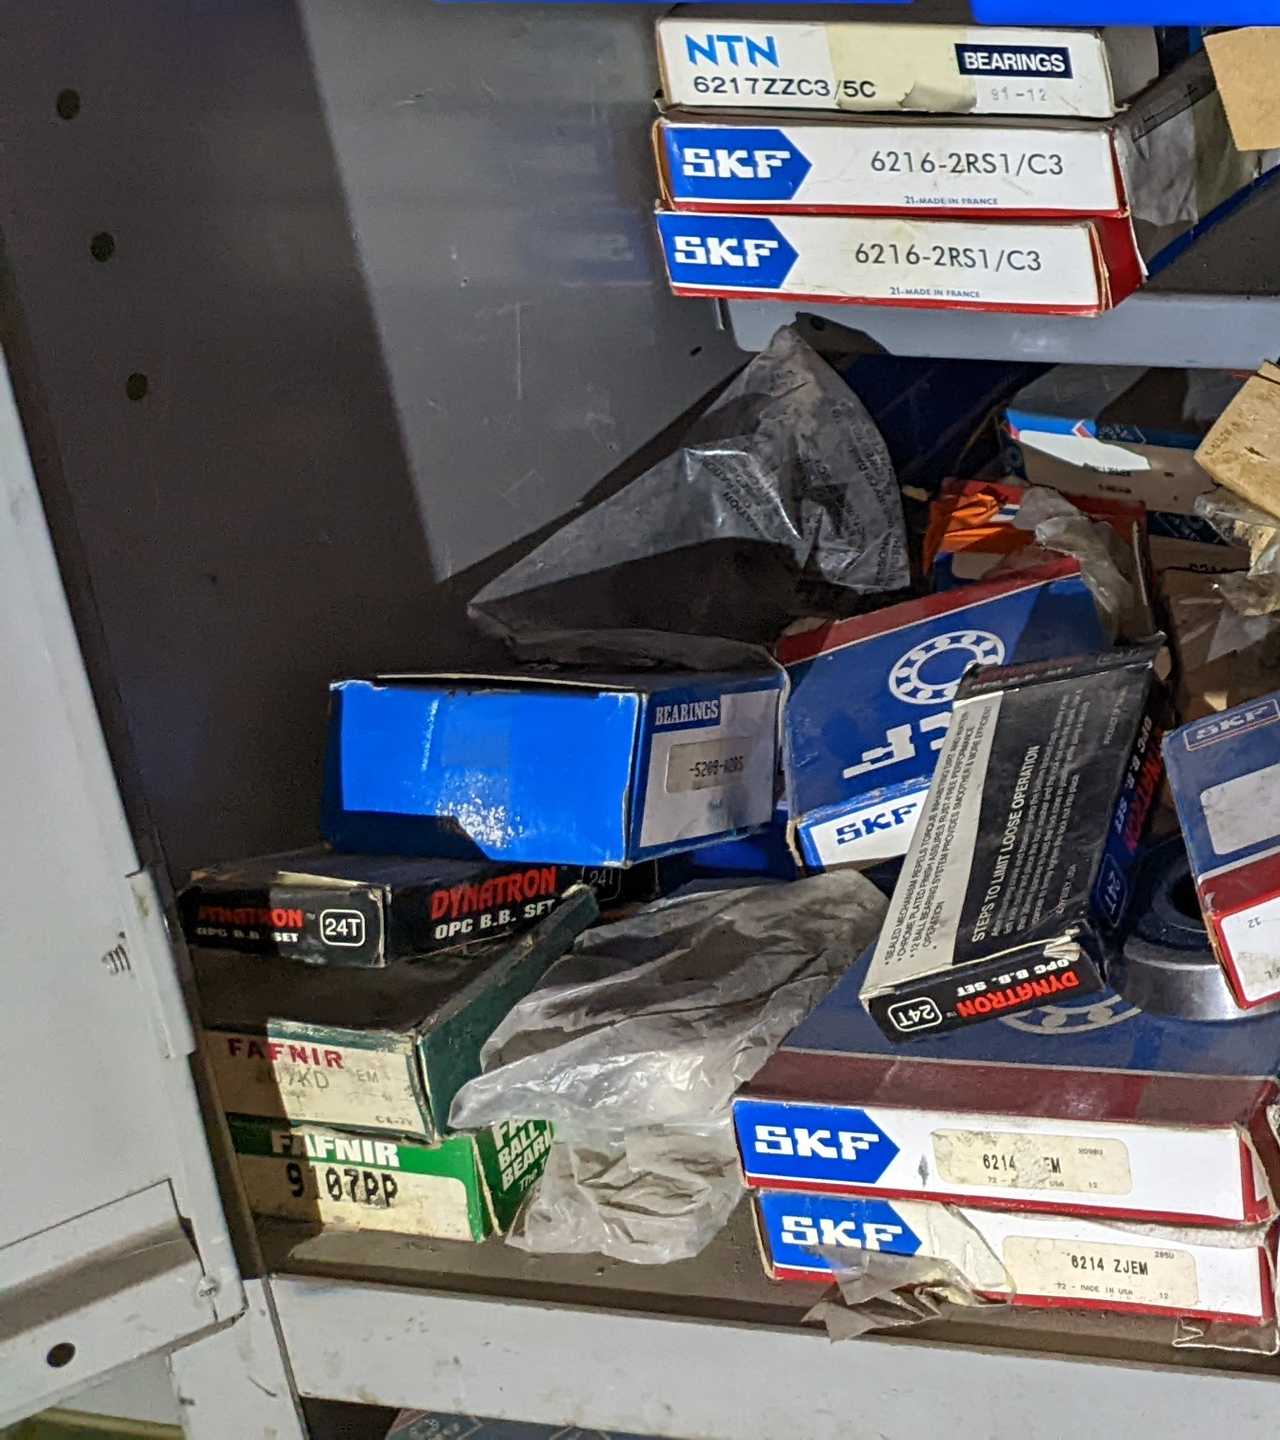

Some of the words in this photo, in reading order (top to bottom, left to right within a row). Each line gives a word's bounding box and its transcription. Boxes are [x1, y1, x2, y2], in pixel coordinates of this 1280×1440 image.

[685, 34, 780, 68] NTN
[963, 52, 1066, 74] BEARINGS
[693, 76, 877, 101] 6217ZZC3/5C
[682, 147, 791, 180] SKF
[871, 150, 1064, 178] 6216-2RS1/C3
[961, 197, 998, 206] FRANCE
[674, 236, 779, 267] SKF
[854, 243, 1042, 273] 6216-2RS1/C3
[945, 289, 981, 299] FRANCE
[655, 699, 719, 727] BEARINGS
[1195, 704, 1273, 736] SKF
[1011, 742, 1041, 808] OPERATION
[836, 802, 918, 846] SKF
[998, 808, 1023, 853] LOOSE
[990, 852, 1010, 883] LIMIT
[430, 867, 557, 921] DYNATRON
[984, 882, 1001, 903] TO
[324, 917, 361, 938] 24T
[434, 919, 474, 941] OPC
[480, 907, 517, 929] B.B.
[524, 899, 556, 920] SET
[921, 899, 945, 947] OPERATION
[971, 900, 996, 944] STEPS
[271, 931, 299, 944] SET
[956, 970, 1081, 1018] DYNATRON
[957, 980, 988, 997] SET
[899, 1002, 935, 1028] 24T
[227, 1037, 345, 1070] FAFNIR
[271, 1130, 400, 1168] FAFNIR
[754, 1125, 880, 1161] SKF
[982, 1153, 1017, 1171] 6214
[287, 1163, 399, 1208] 907PP
[781, 1216, 902, 1251] SKF
[1071, 1254, 1105, 1271] 6214
[1114, 1258, 1149, 1276] ZJEM
